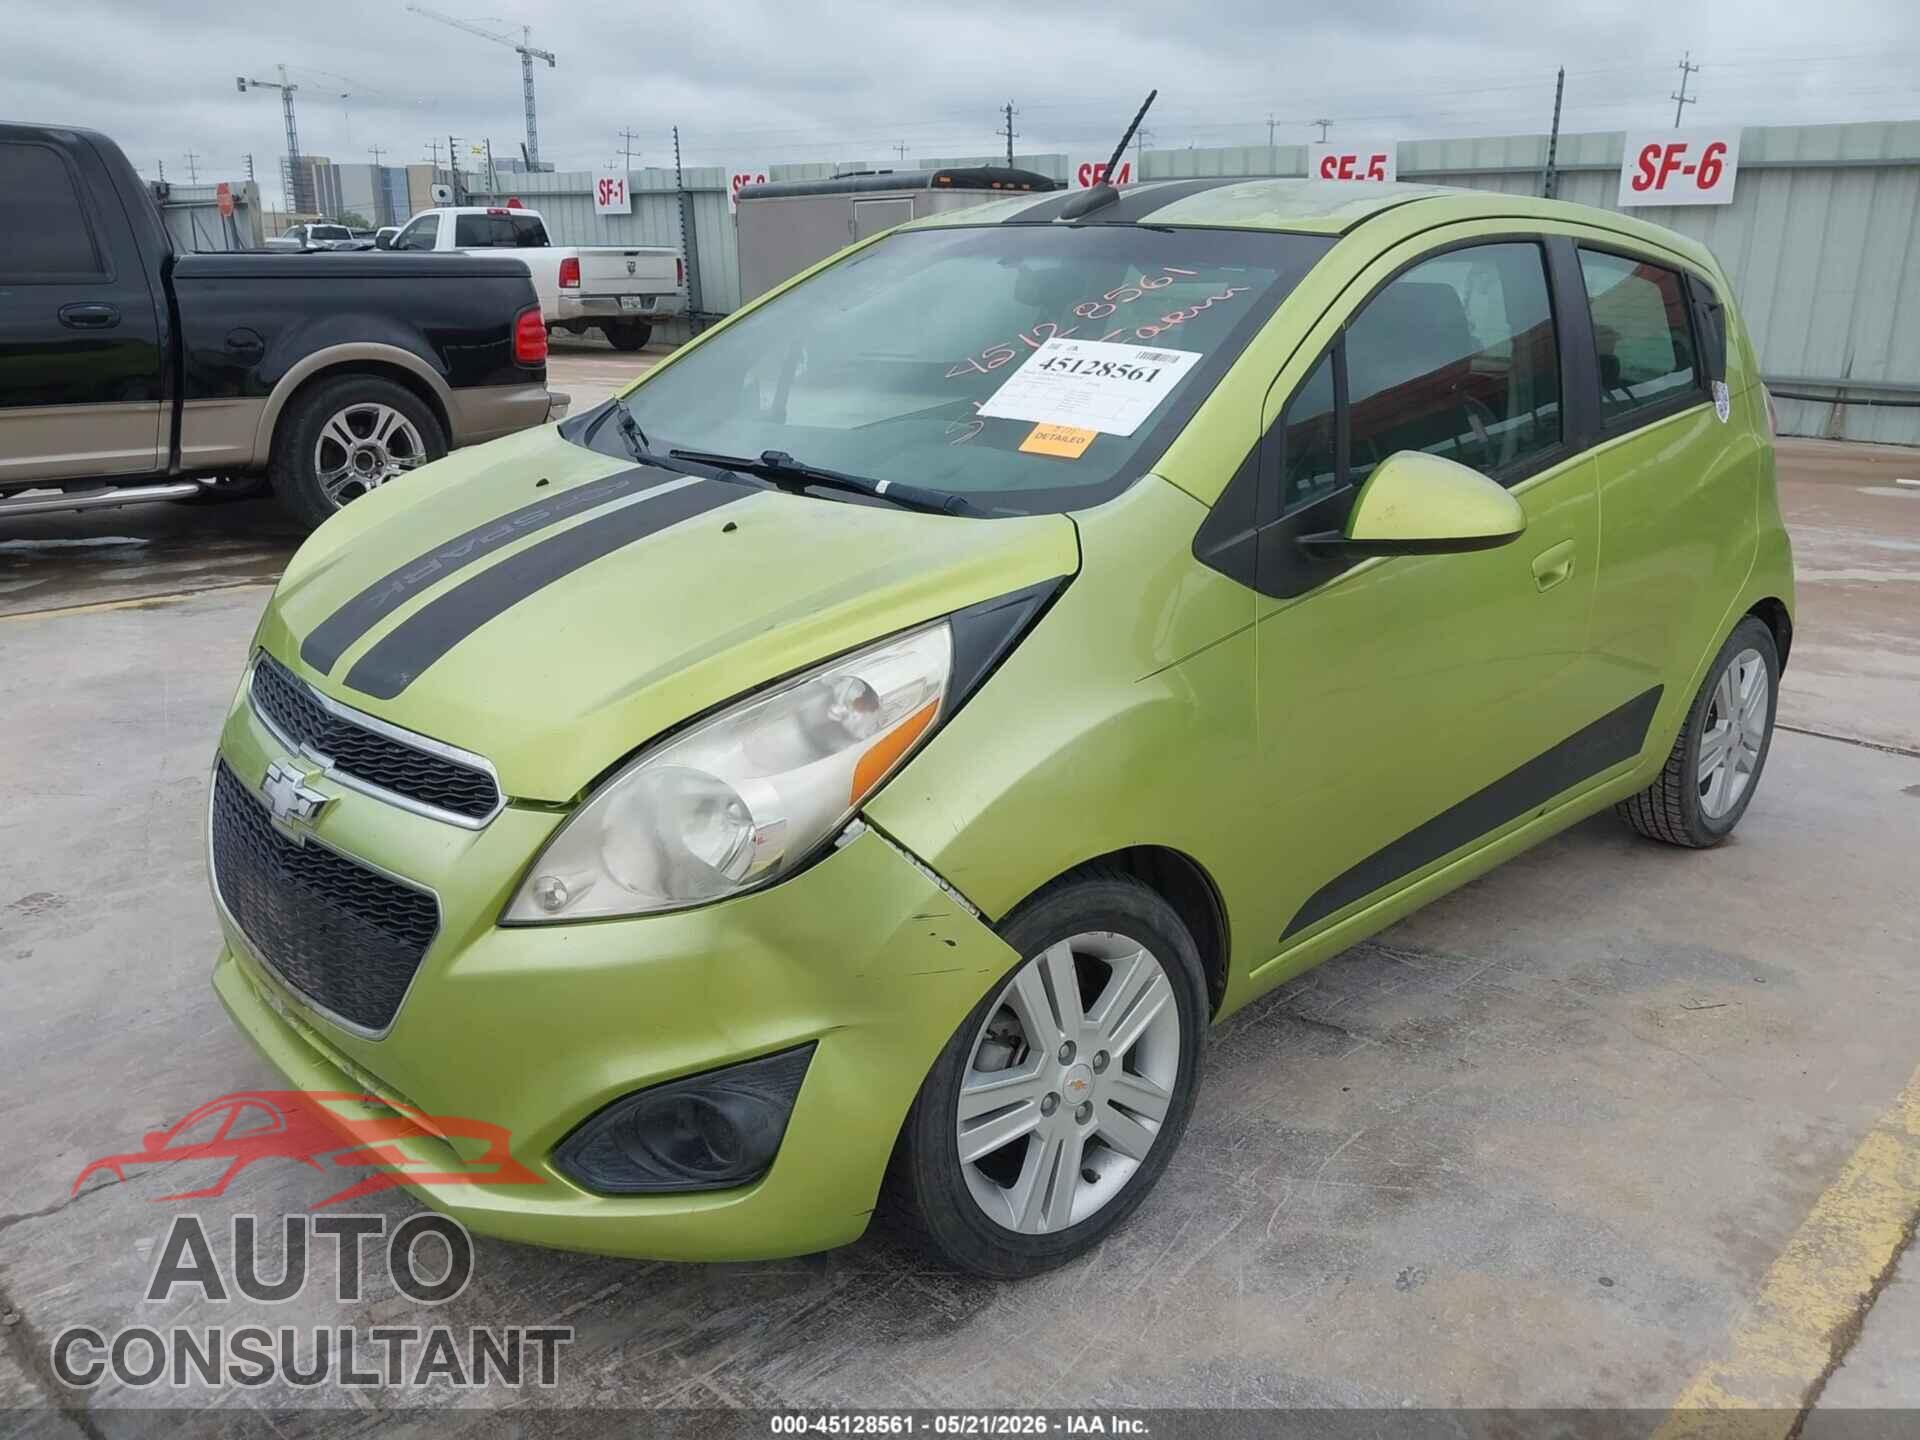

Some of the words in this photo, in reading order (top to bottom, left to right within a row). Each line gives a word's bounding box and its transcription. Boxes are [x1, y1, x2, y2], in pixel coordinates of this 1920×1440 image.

[1632, 142, 1727, 191] SF-6
[599, 178, 625, 206] SF-1
[1038, 354, 1162, 384] 45128561
